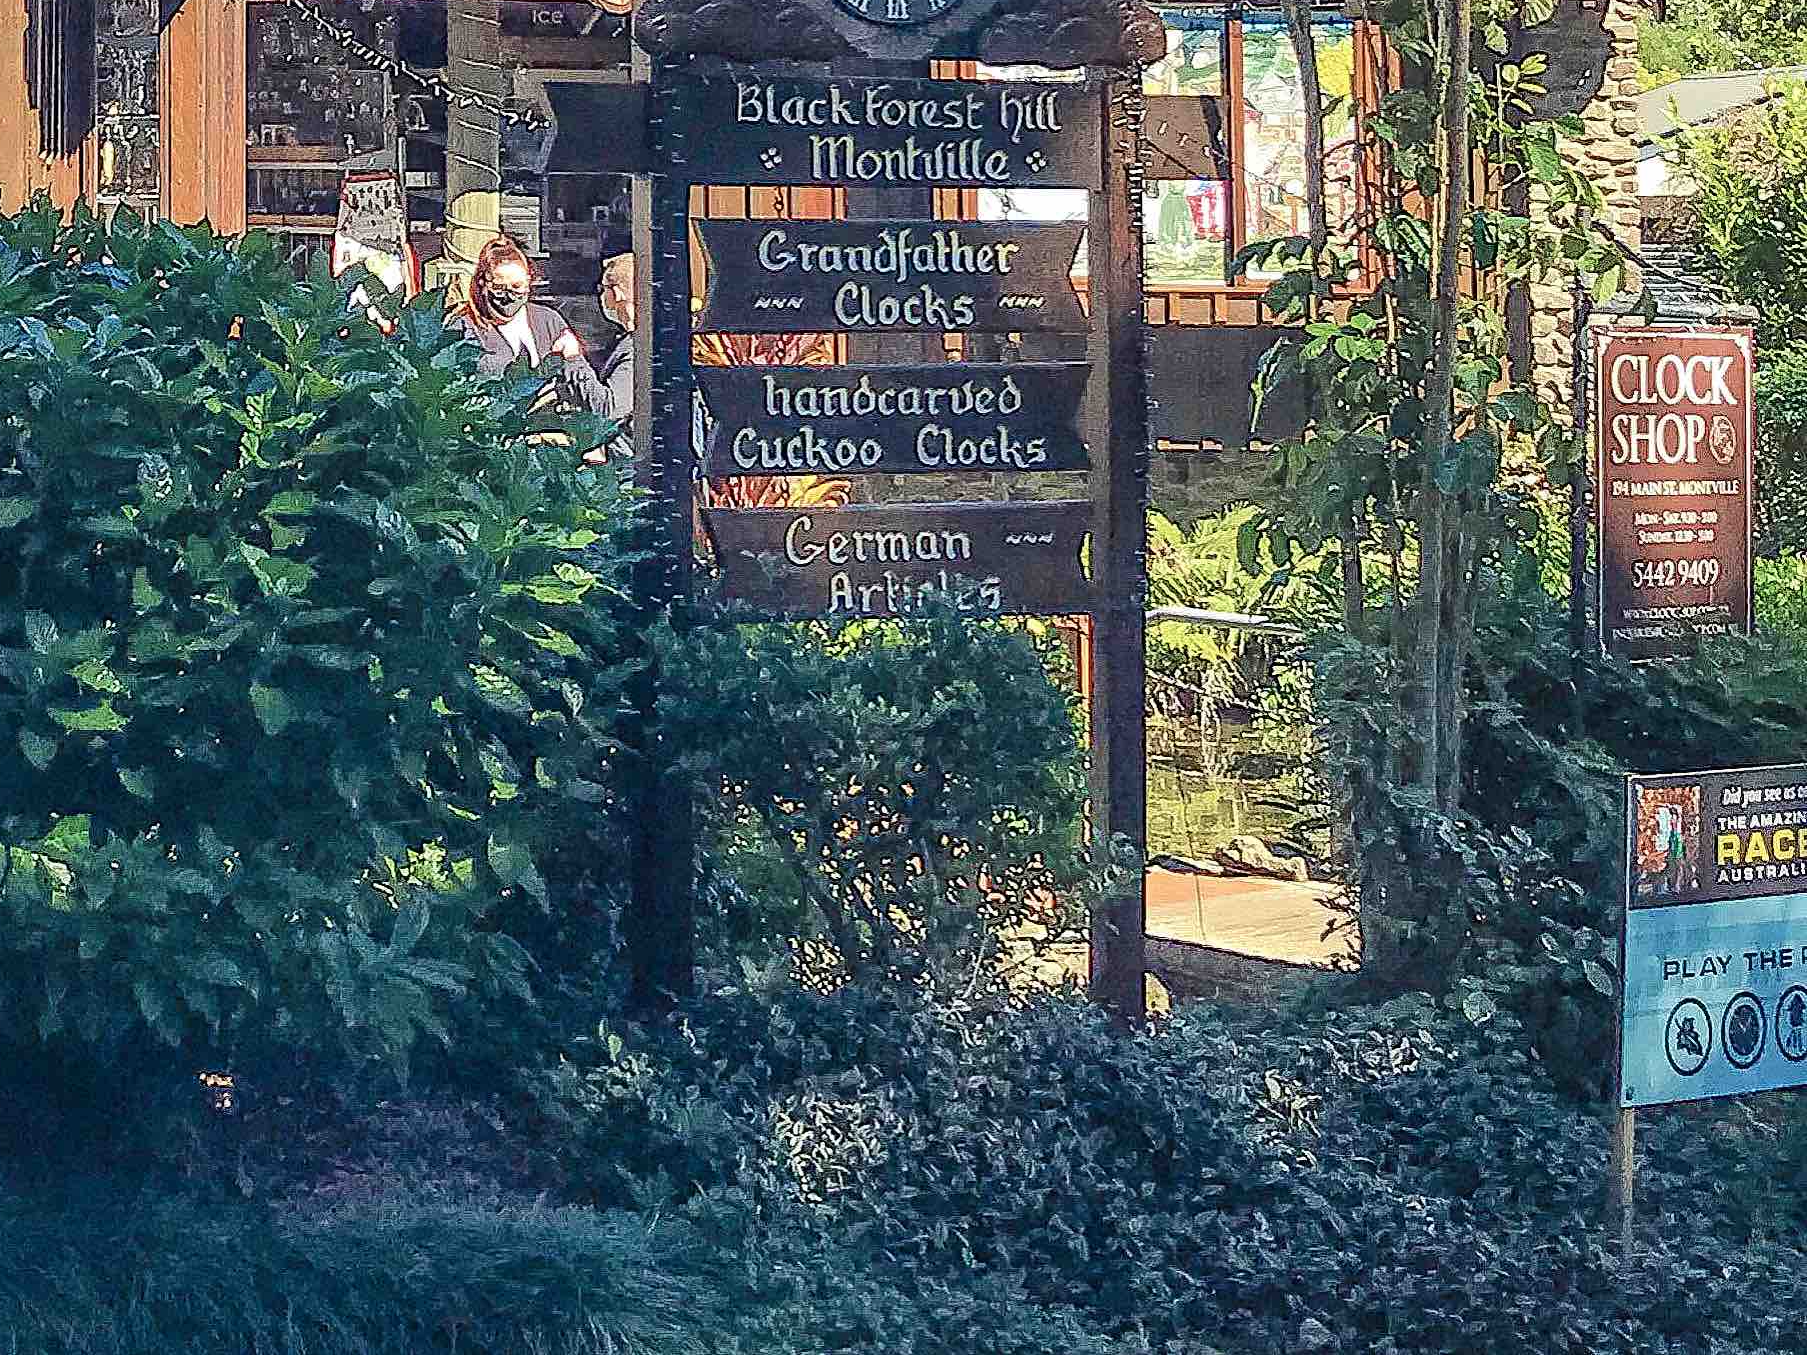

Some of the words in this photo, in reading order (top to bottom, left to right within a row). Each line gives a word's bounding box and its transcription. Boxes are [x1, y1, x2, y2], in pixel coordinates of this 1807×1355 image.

[736, 82, 860, 126] Black
[808, 133, 1012, 181] Montville
[758, 227, 1021, 282] Grandfather
[834, 283, 975, 328] Clocks
[1611, 354, 1738, 405] CLOCK
[733, 428, 883, 470] Cuckoo
[915, 425, 1047, 468] Clocks
[1611, 413, 1706, 464] SHOP
[1631, 481, 1663, 496] MAIN
[1678, 479, 1741, 496] MONTVILLE
[786, 515, 971, 566] German
[1632, 562, 1675, 588] 5442
[1677, 559, 1719, 585] 9409
[1723, 786, 1742, 805] Did
[1742, 789, 1762, 809] you
[1763, 787, 1782, 802] see
[1717, 815, 1747, 831] THE
[1663, 953, 1733, 980] PLAY
[1743, 947, 1793, 971] THE
